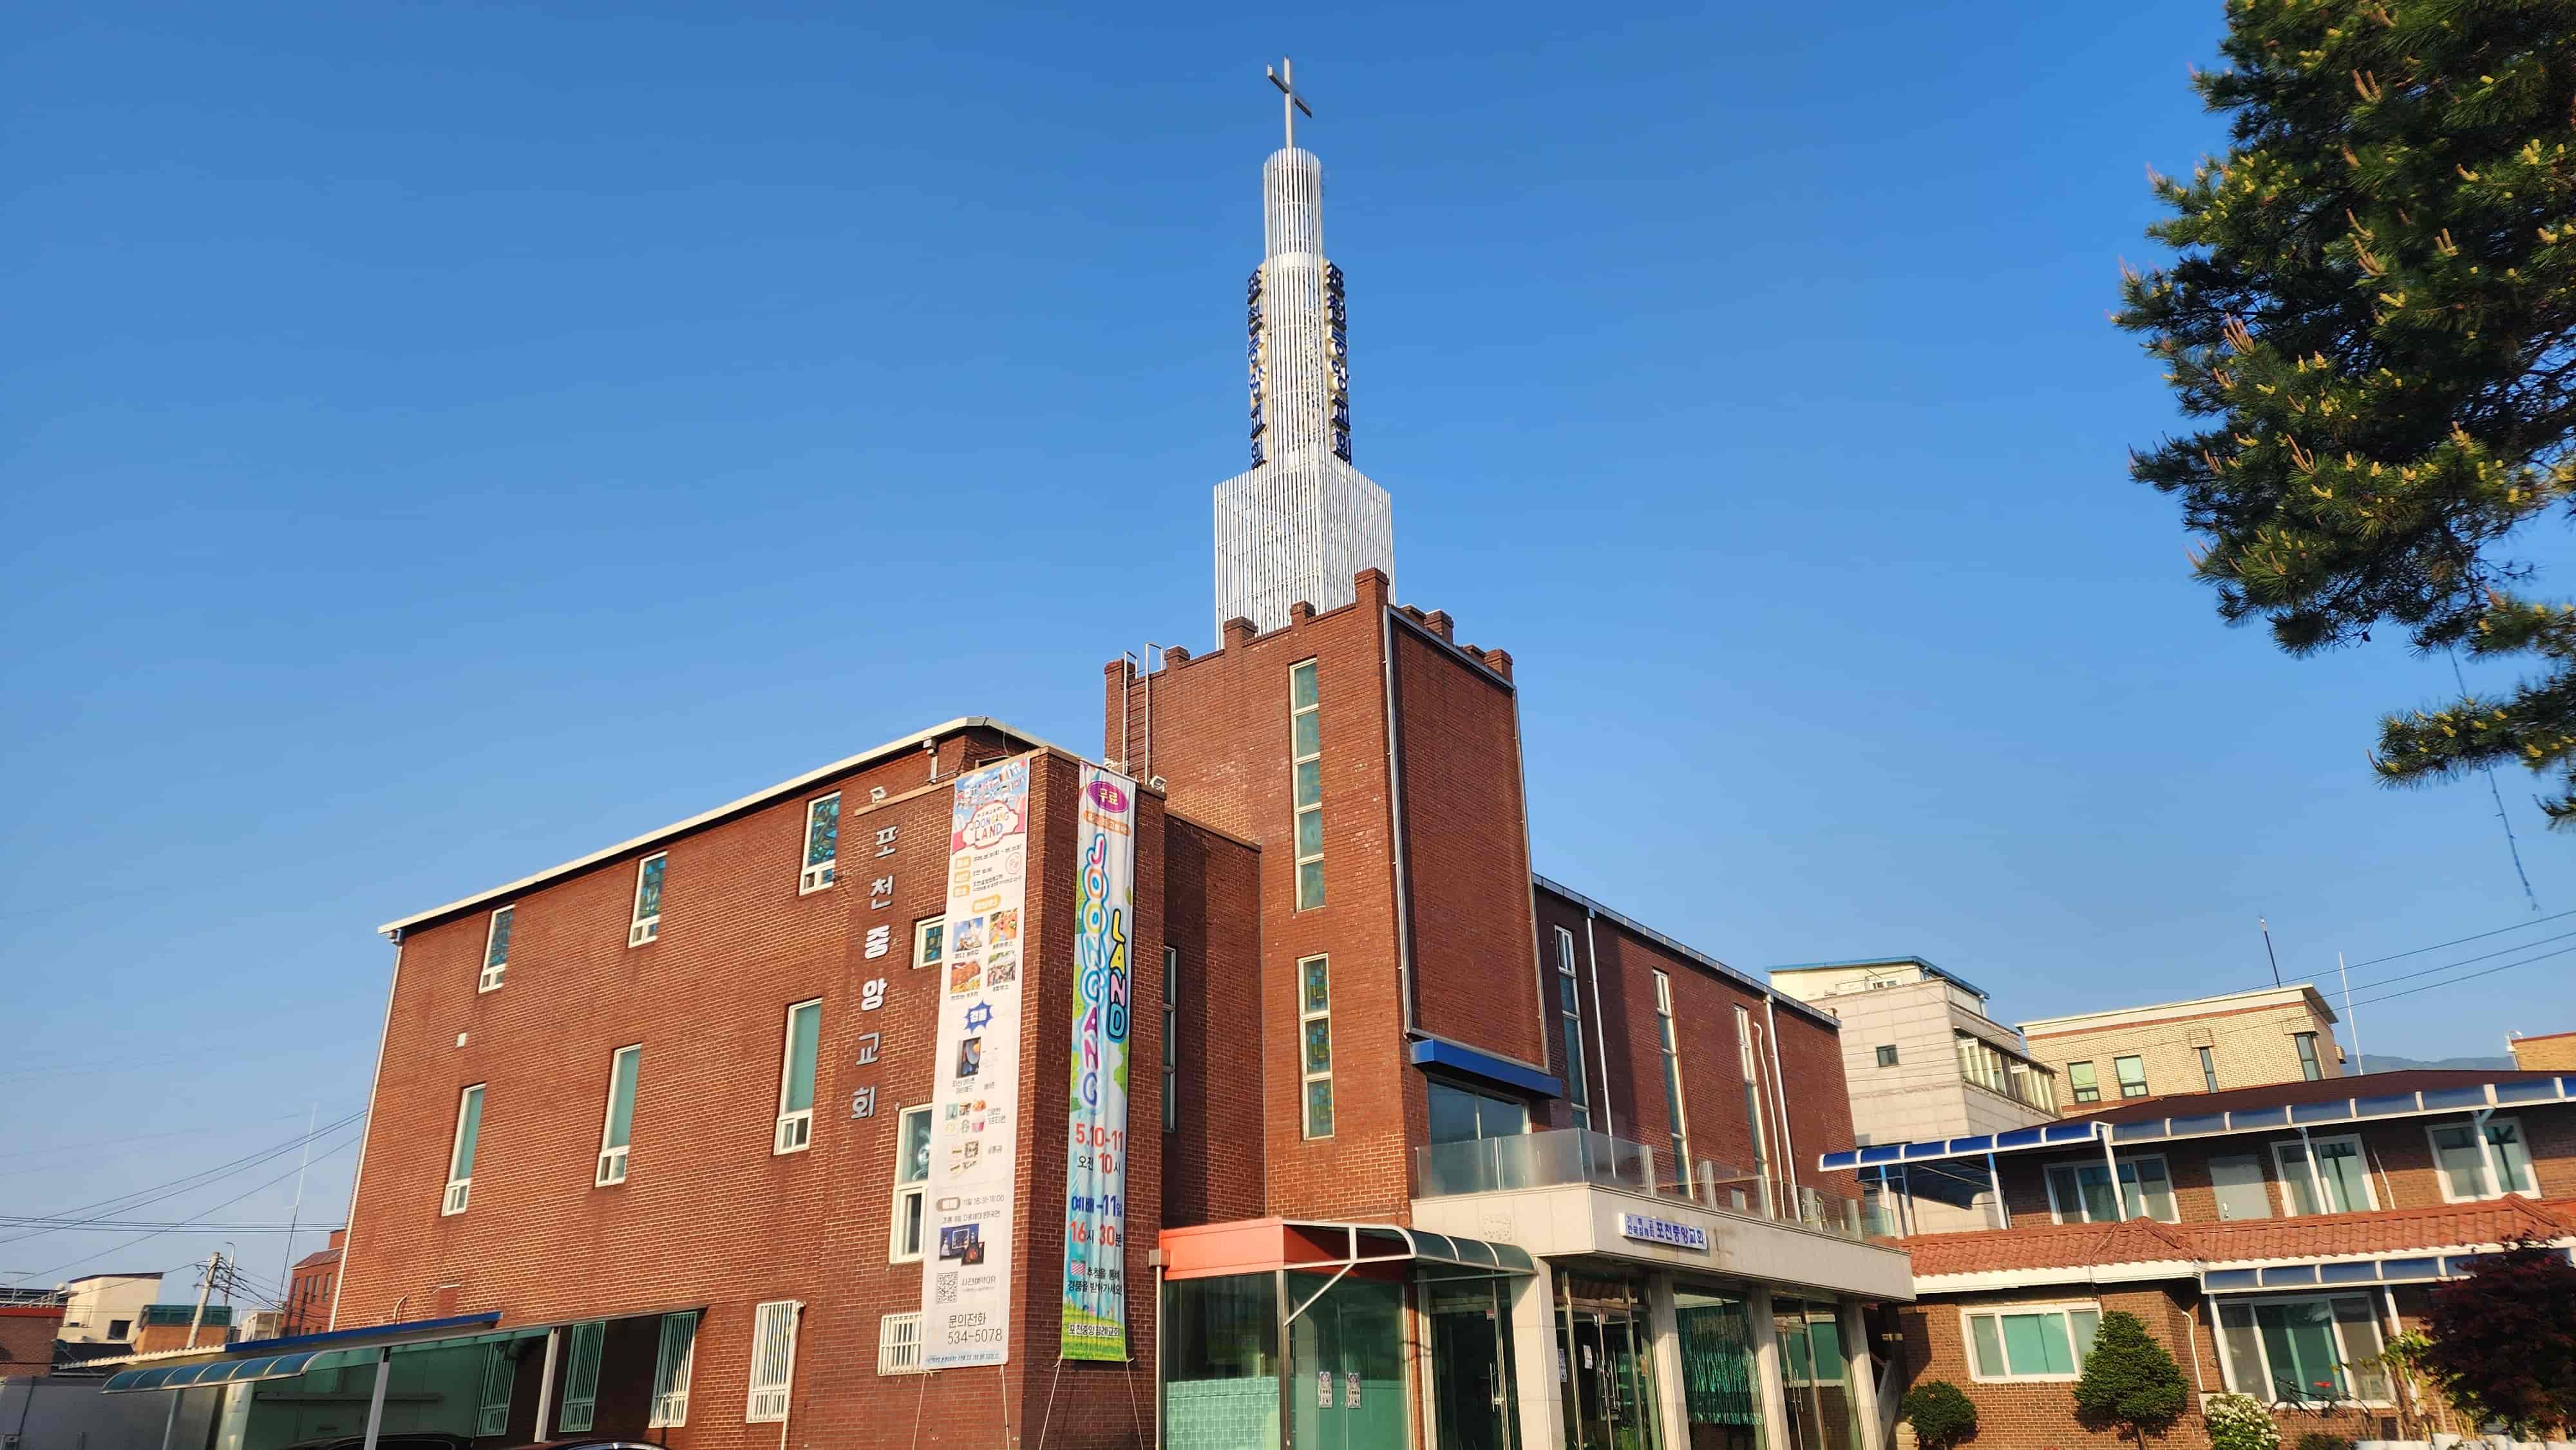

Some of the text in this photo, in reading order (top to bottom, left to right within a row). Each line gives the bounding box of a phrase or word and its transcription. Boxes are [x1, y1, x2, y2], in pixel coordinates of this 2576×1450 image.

[1099, 787, 1119, 805] 무료
[975, 823, 1003, 842] LAND
[1081, 833, 1109, 1107] JOONGANG
[1107, 909, 1126, 1042] LAND
[1077, 1155, 1094, 1171] 오전
[1656, 1221, 1704, 1246] 포천중앙교회
[1067, 1280, 1088, 1292] 경품을
[949, 1312, 986, 1328] 문의전화
[948, 1328, 1002, 1344] 534-5078
